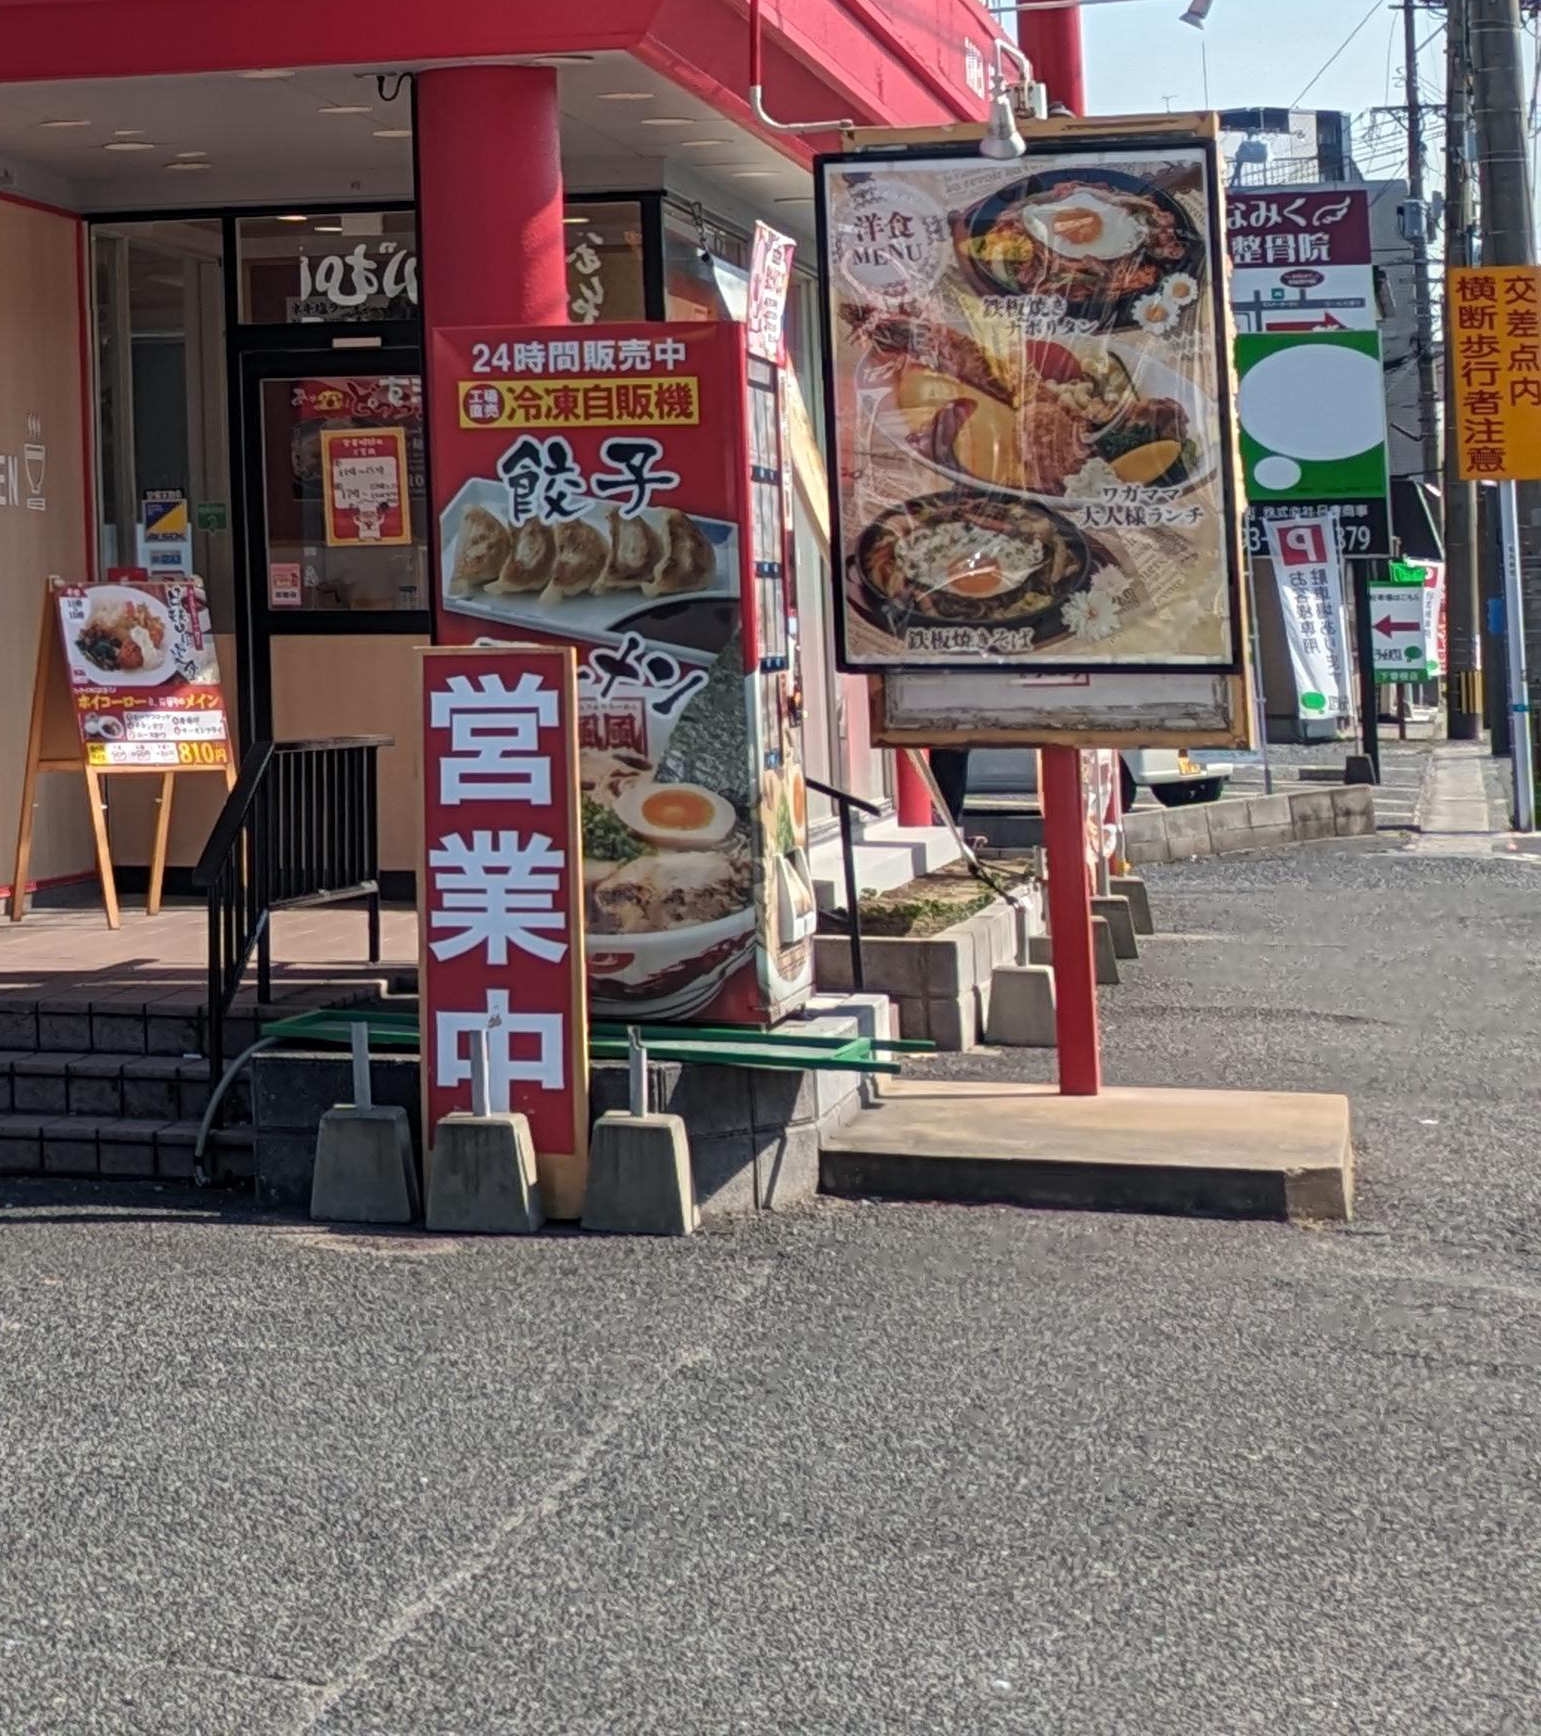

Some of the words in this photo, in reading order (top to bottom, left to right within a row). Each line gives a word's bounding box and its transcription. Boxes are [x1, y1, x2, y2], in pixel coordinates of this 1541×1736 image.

[853, 211, 915, 242] 洋食
[853, 243, 923, 267] MENU
[1231, 231, 1331, 264] 整骨院
[472, 337, 686, 373] 24時間販売中
[1503, 275, 1541, 407] 交差点内
[1455, 275, 1507, 473] 横断歩行者注意
[506, 381, 694, 423] 冷凍自販機
[497, 434, 681, 523] 餃子
[1103, 486, 1181, 503] ワガママ
[1080, 505, 1205, 526] 大人様ランチ
[908, 627, 1034, 651] 鉄板焼きそば
[429, 671, 568, 1113] 営業中
